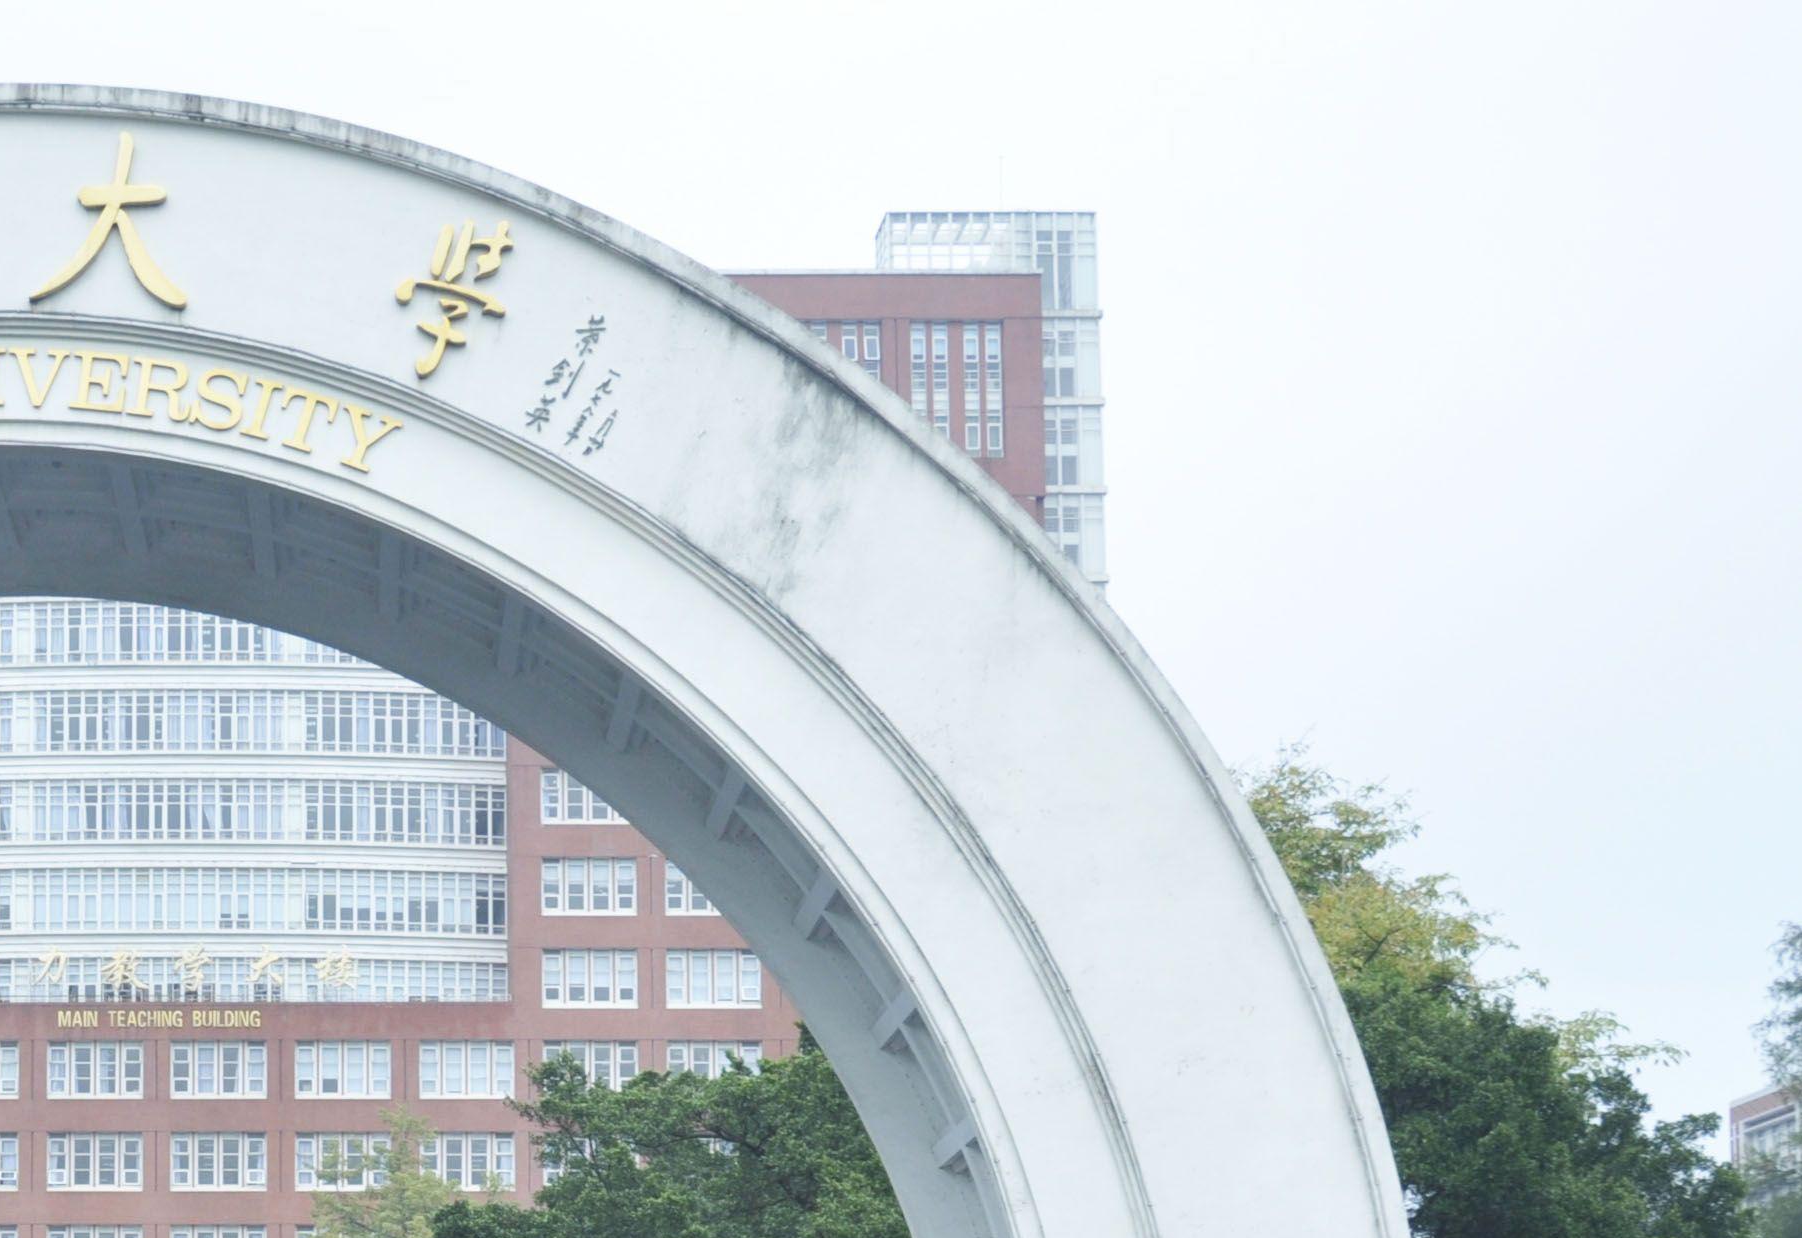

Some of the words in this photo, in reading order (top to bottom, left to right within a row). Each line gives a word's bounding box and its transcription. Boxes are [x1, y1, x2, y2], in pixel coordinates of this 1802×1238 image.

[57, 1009, 99, 1028] MAIN
[108, 1009, 184, 1028] TEACHING
[192, 1009, 261, 1028] BUILDING
